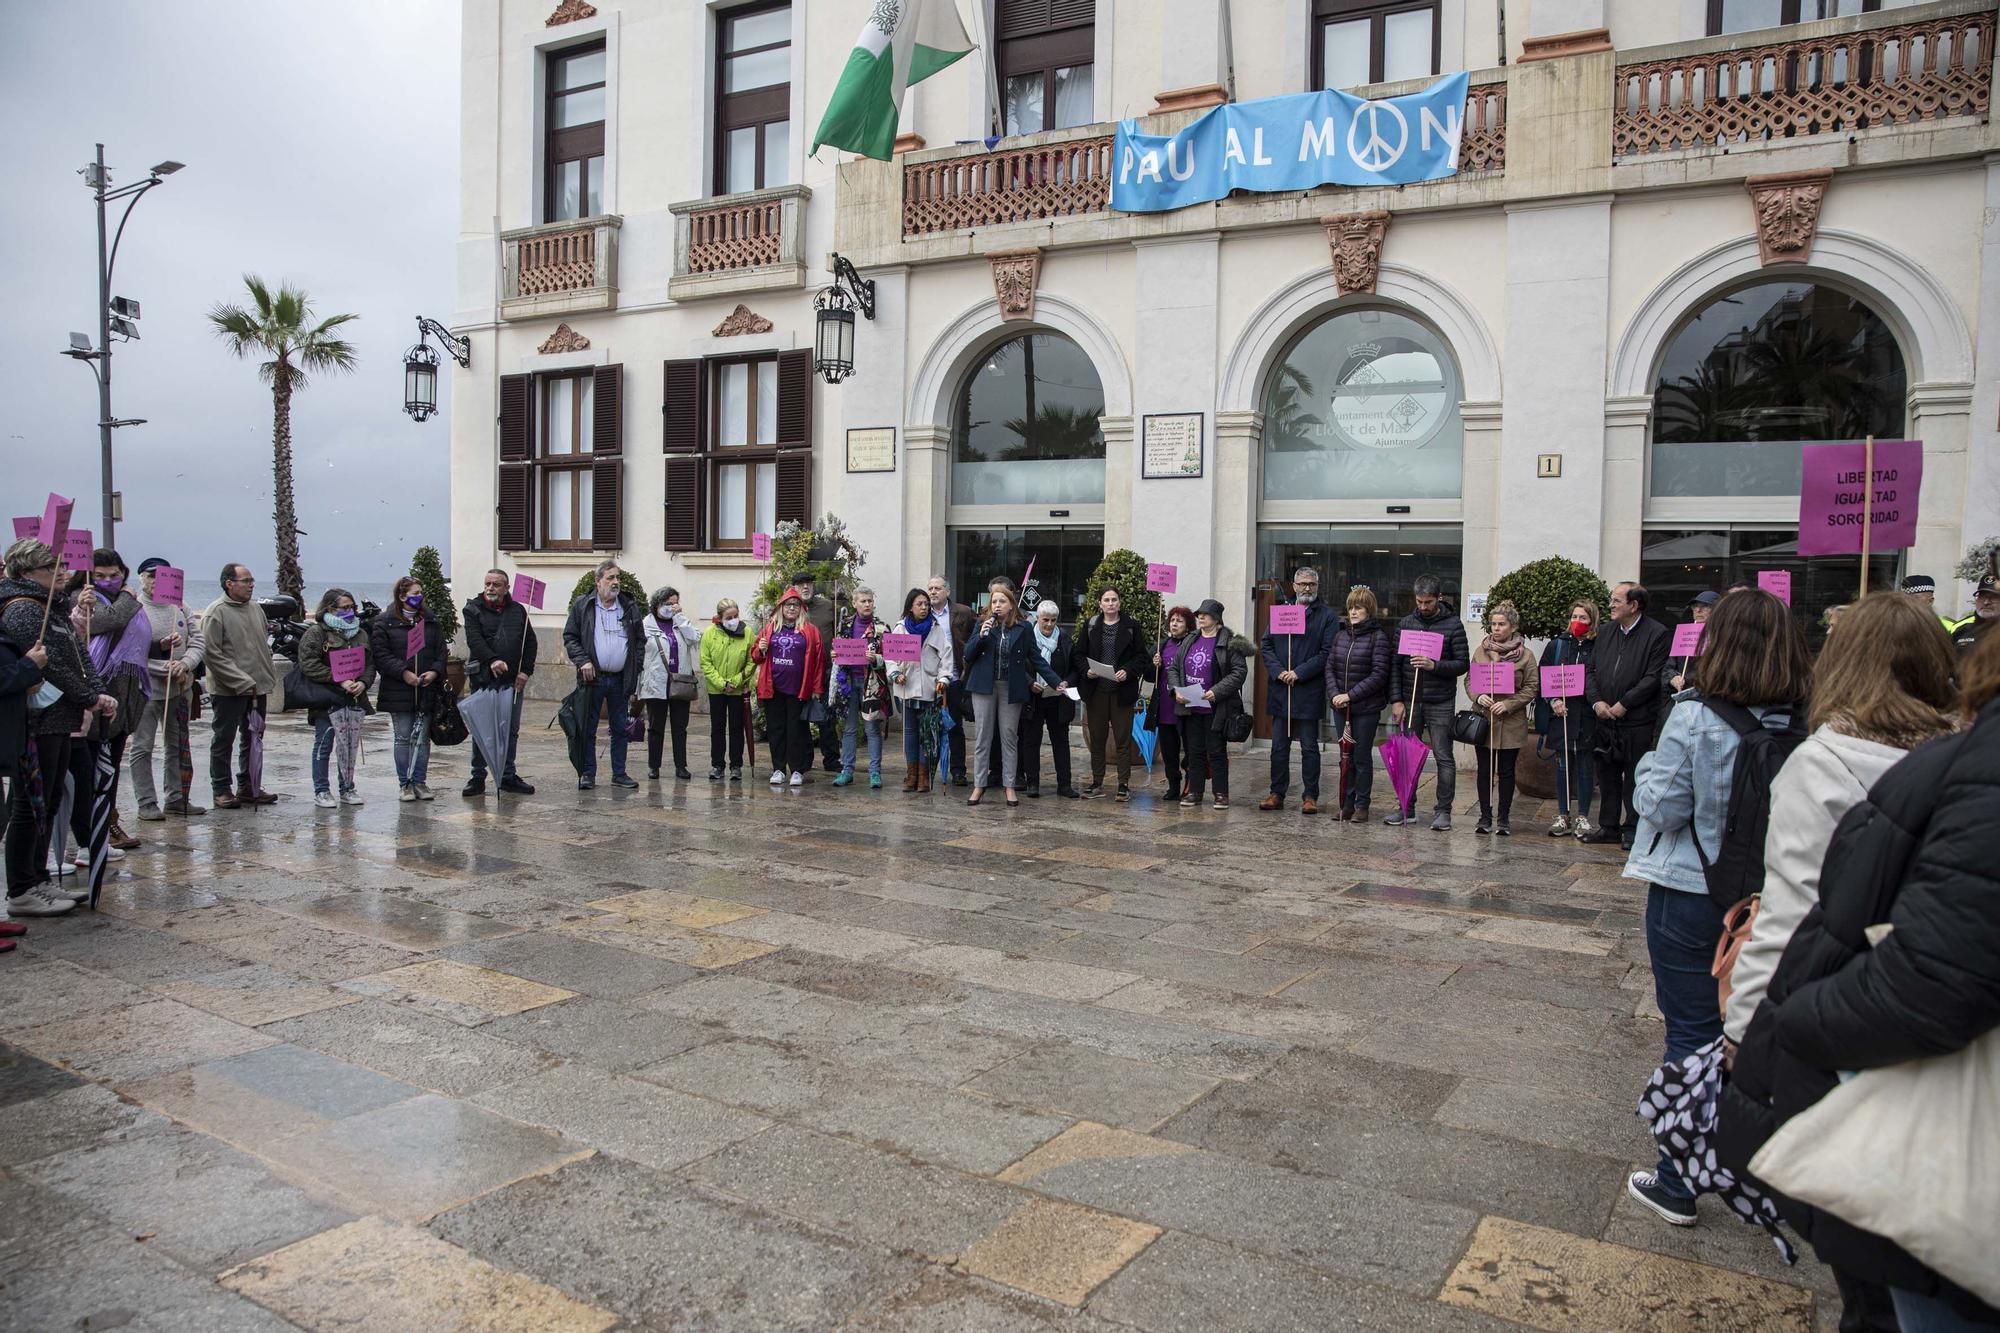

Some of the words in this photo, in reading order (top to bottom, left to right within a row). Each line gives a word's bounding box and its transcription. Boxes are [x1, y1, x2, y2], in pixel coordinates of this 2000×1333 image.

[1118, 137, 1196, 186] PAU
[1223, 126, 1273, 171] AL
[1545, 458, 1552, 472] 1
[1834, 490, 1897, 505] IGUATAD
